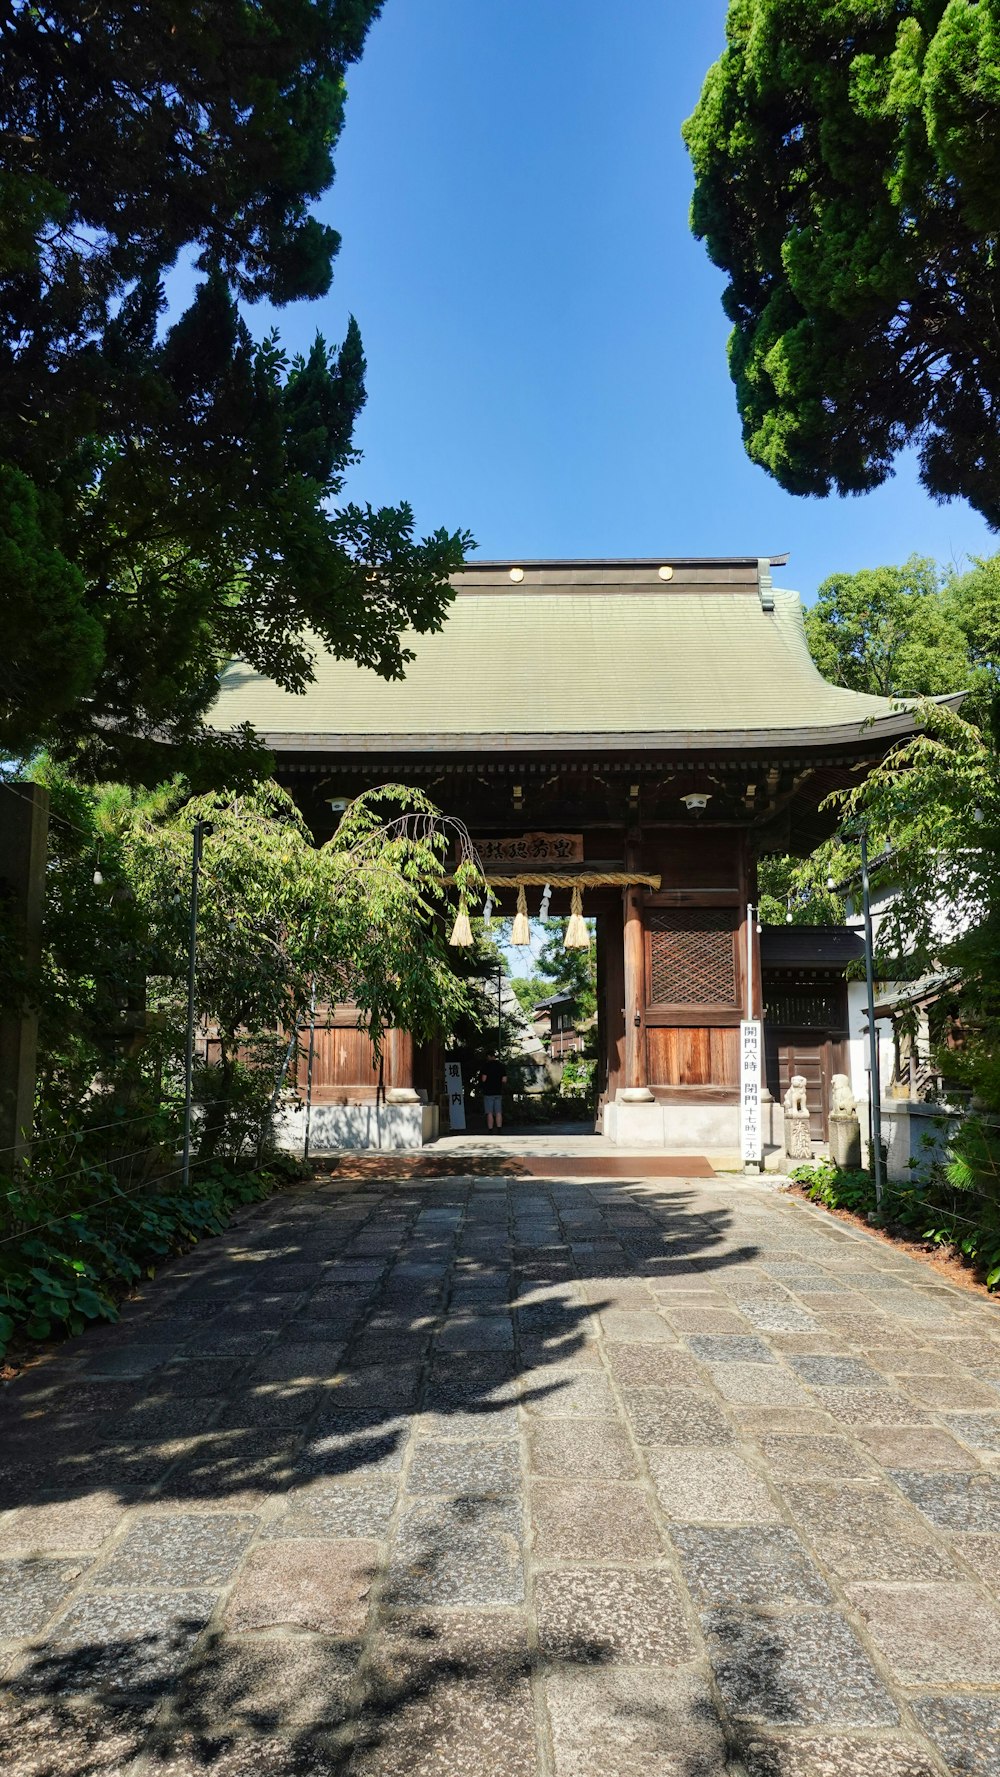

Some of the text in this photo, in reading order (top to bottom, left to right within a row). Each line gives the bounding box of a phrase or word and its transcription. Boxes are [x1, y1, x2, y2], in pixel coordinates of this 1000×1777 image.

[448, 1064, 462, 1105] 境内
[744, 1026, 757, 1158] 開門六時 閉門十七時二十分
